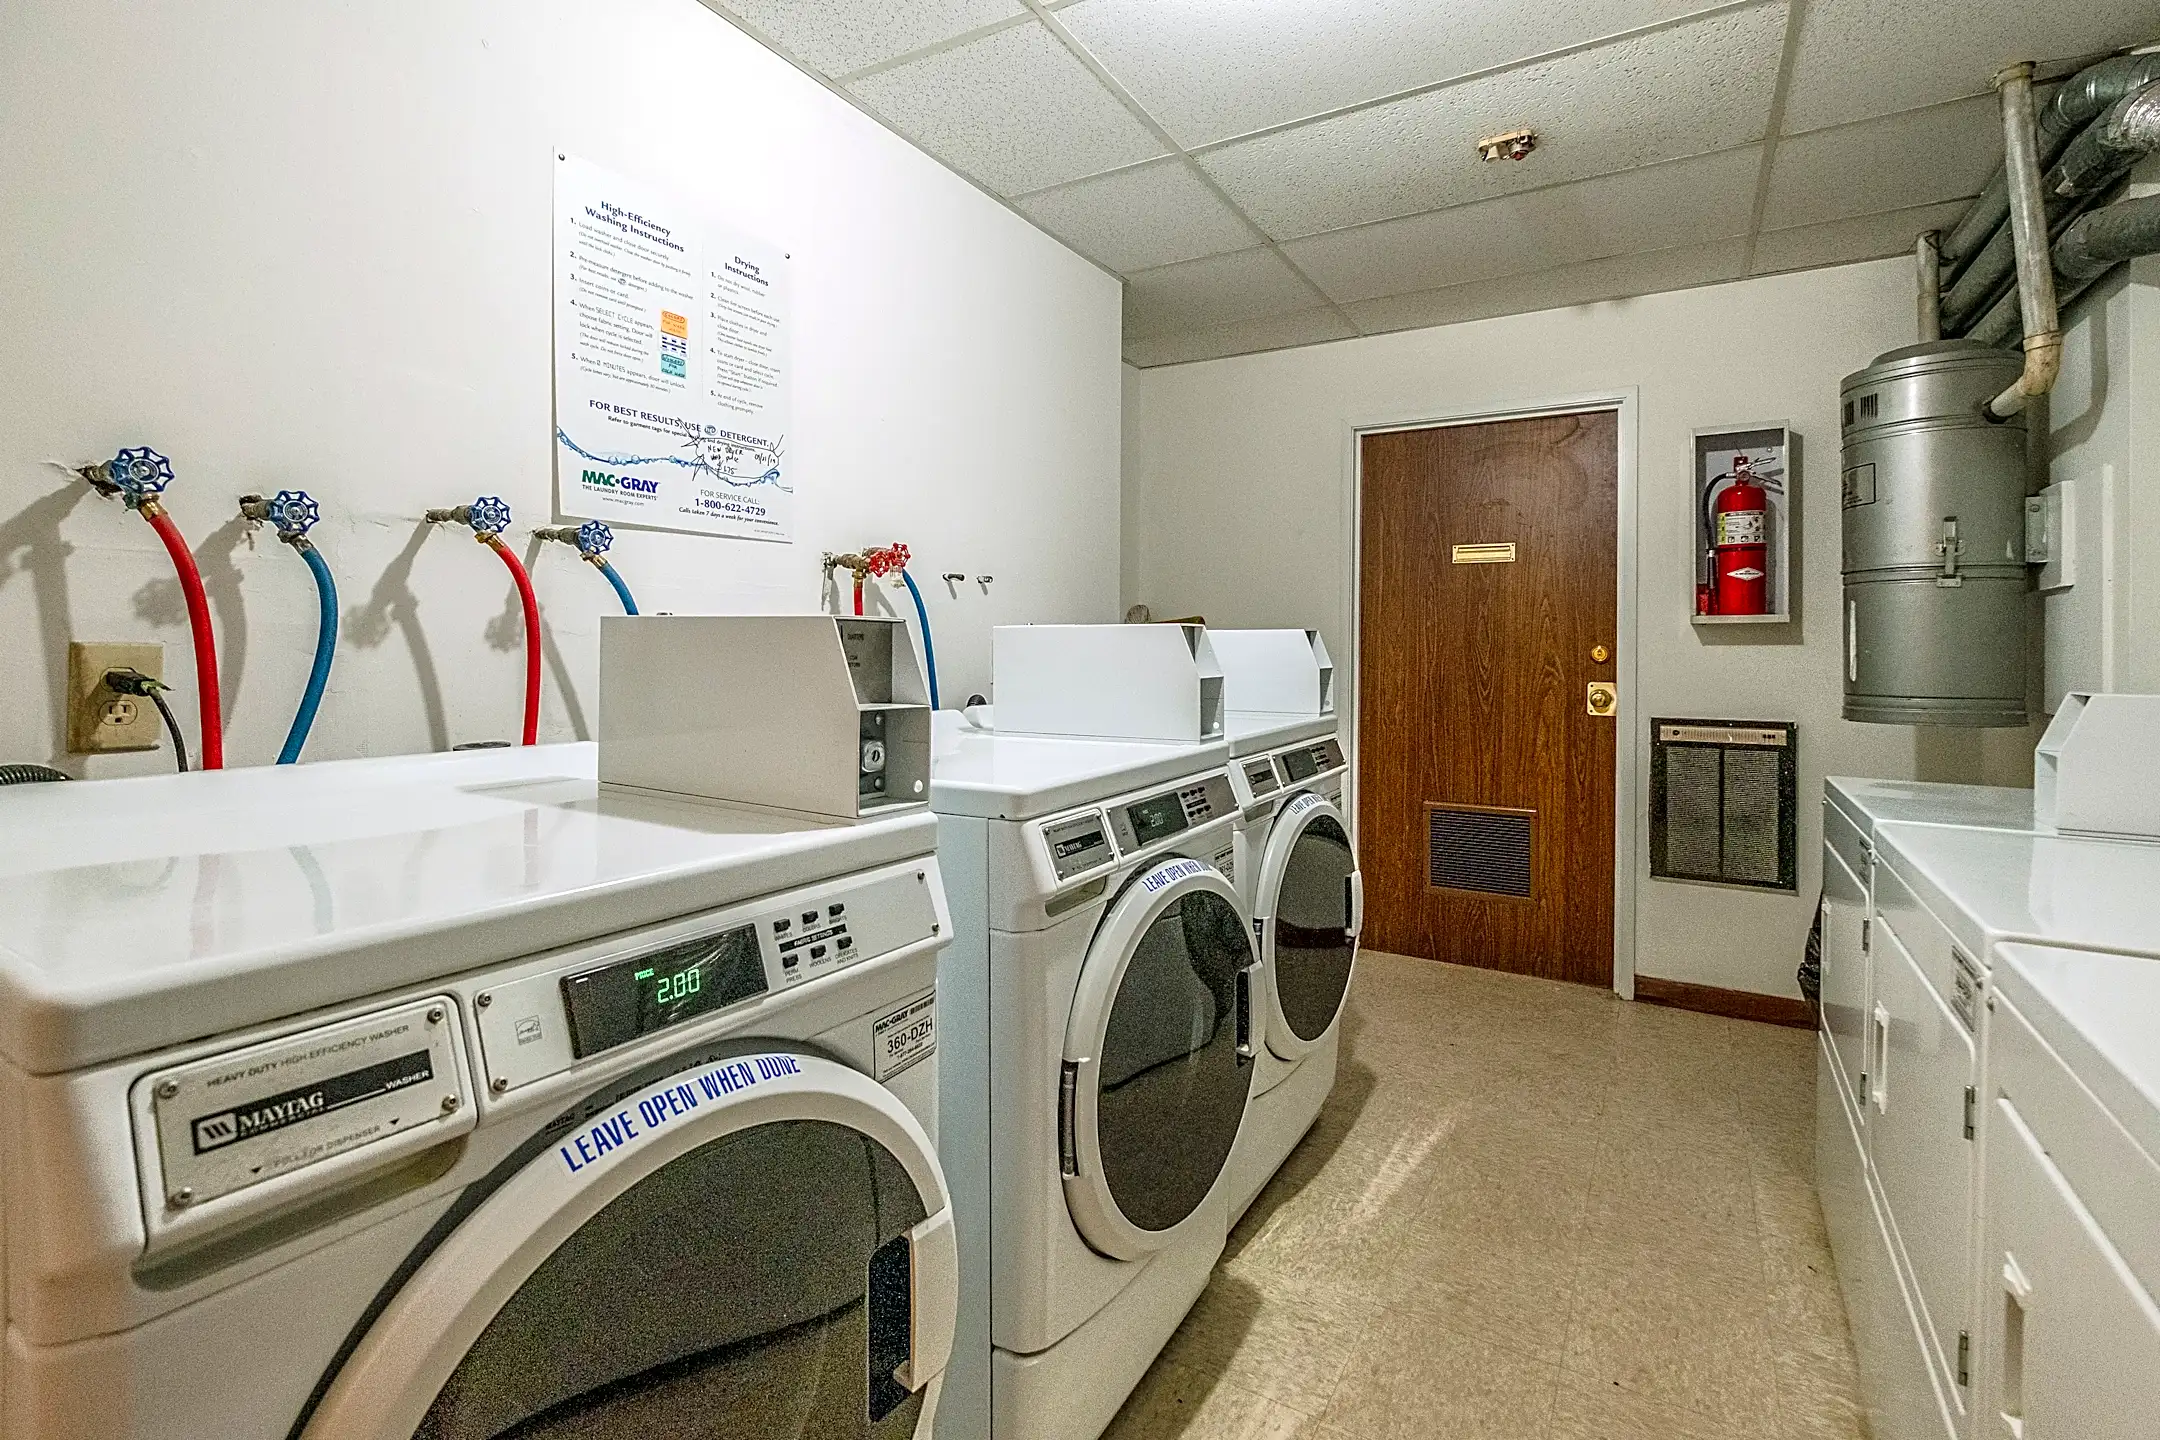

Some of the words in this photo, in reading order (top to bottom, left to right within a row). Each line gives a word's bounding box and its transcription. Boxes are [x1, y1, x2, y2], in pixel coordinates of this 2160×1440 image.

[570, 217, 576, 225] 1.
[594, 229, 612, 238] washer
[585, 207, 627, 232] Washing
[631, 225, 684, 252] Instructions
[601, 202, 670, 237] High-Efficiency
[725, 263, 768, 286] Instructions
[735, 256, 760, 274] Drying
[570, 273, 577, 281] 3.
[579, 278, 594, 287] Insert
[633, 275, 647, 284] before
[648, 282, 664, 291] adding
[579, 303, 595, 311] When
[595, 307, 615, 317] SELECT
[617, 314, 633, 324] CYCLE
[634, 321, 654, 330] appears,
[579, 313, 597, 321] choose
[598, 317, 612, 326] fabric
[579, 321, 590, 329] lock
[580, 356, 596, 364] When
[603, 362, 626, 373] MINUTES
[627, 370, 647, 379] appears,
[590, 400, 610, 411] FOR
[614, 405, 638, 417] BEST
[640, 411, 682, 428] RESULTS,
[685, 421, 701, 433] USE
[720, 430, 768, 446] DETERGENT.
[593, 486, 618, 494] LAUNDRY
[700, 489, 714, 498] FOR
[716, 492, 741, 502] SERVICE
[743, 496, 760, 505] CALL:
[696, 499, 765, 516] 1-800-622-4729
[710, 511, 721, 519] days
[1142, 870, 1170, 892] LEAVE
[1165, 864, 1184, 881] OPEN
[634, 968, 654, 980] PRICE
[657, 968, 700, 1003] 2.00
[887, 1017, 933, 1053] 360-DZH
[207, 1071, 246, 1087] HEAVY
[248, 1062, 279, 1076] DUTY
[280, 1054, 307, 1067] HIGH
[310, 1038, 368, 1059] EFFICIENCY
[368, 1025, 410, 1042] WASHER
[385, 1070, 430, 1090] WASHER
[240, 1092, 324, 1130] MAYTAG
[560, 1111, 639, 1172] LEAVE
[638, 1084, 698, 1128] OPEN
[698, 1061, 756, 1100] WHEN
[755, 1055, 801, 1080] DONE
[327, 1126, 381, 1152] DISPENSER
